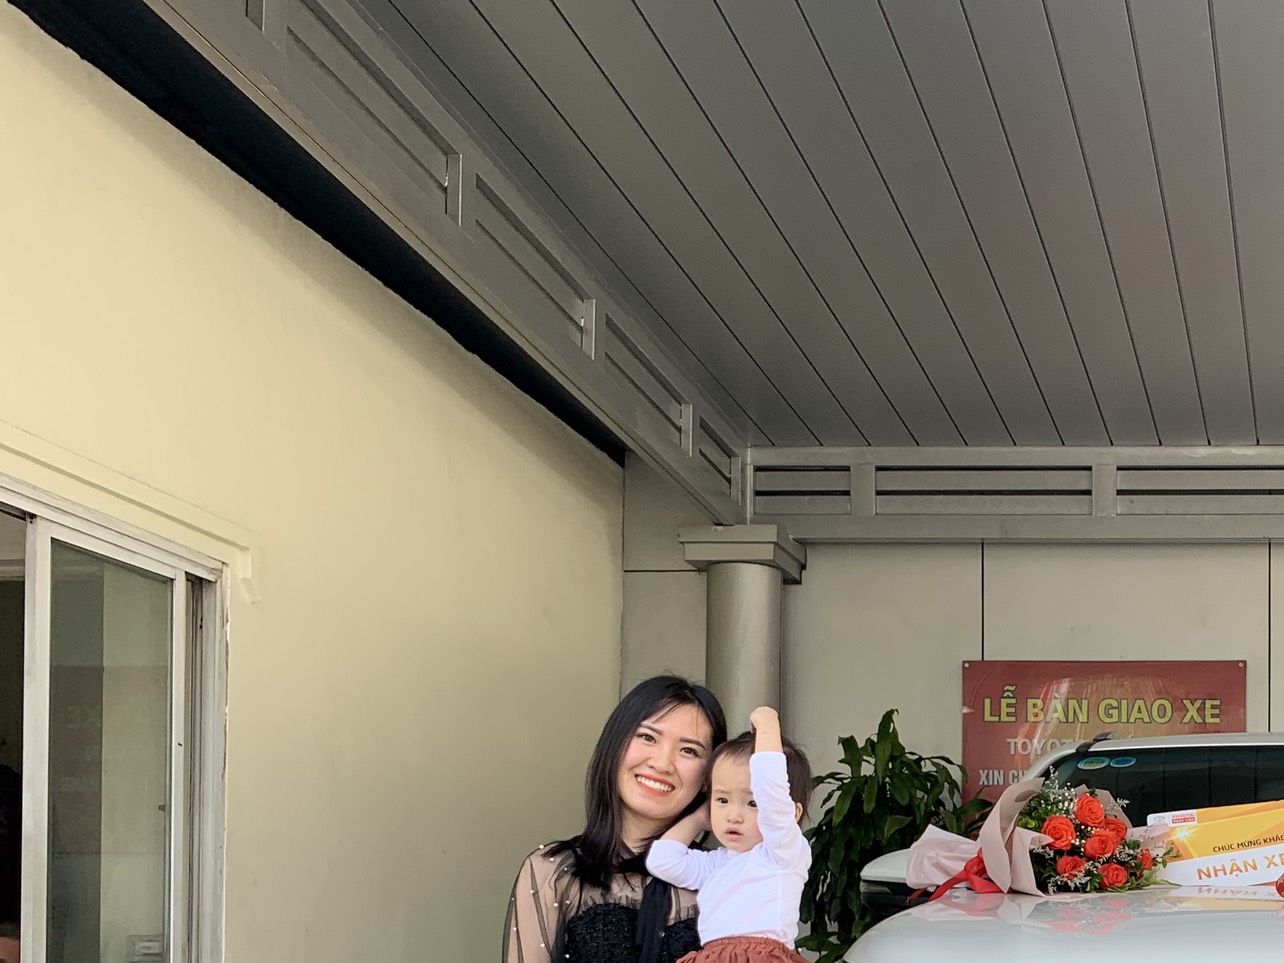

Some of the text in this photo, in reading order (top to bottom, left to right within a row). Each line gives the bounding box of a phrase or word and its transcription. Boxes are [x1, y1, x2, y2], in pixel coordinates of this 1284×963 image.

[982, 685, 1222, 724] LỄ BÀN GIAO XE
[979, 769, 1004, 786] XIN
[1196, 858, 1258, 880] NHẬN
